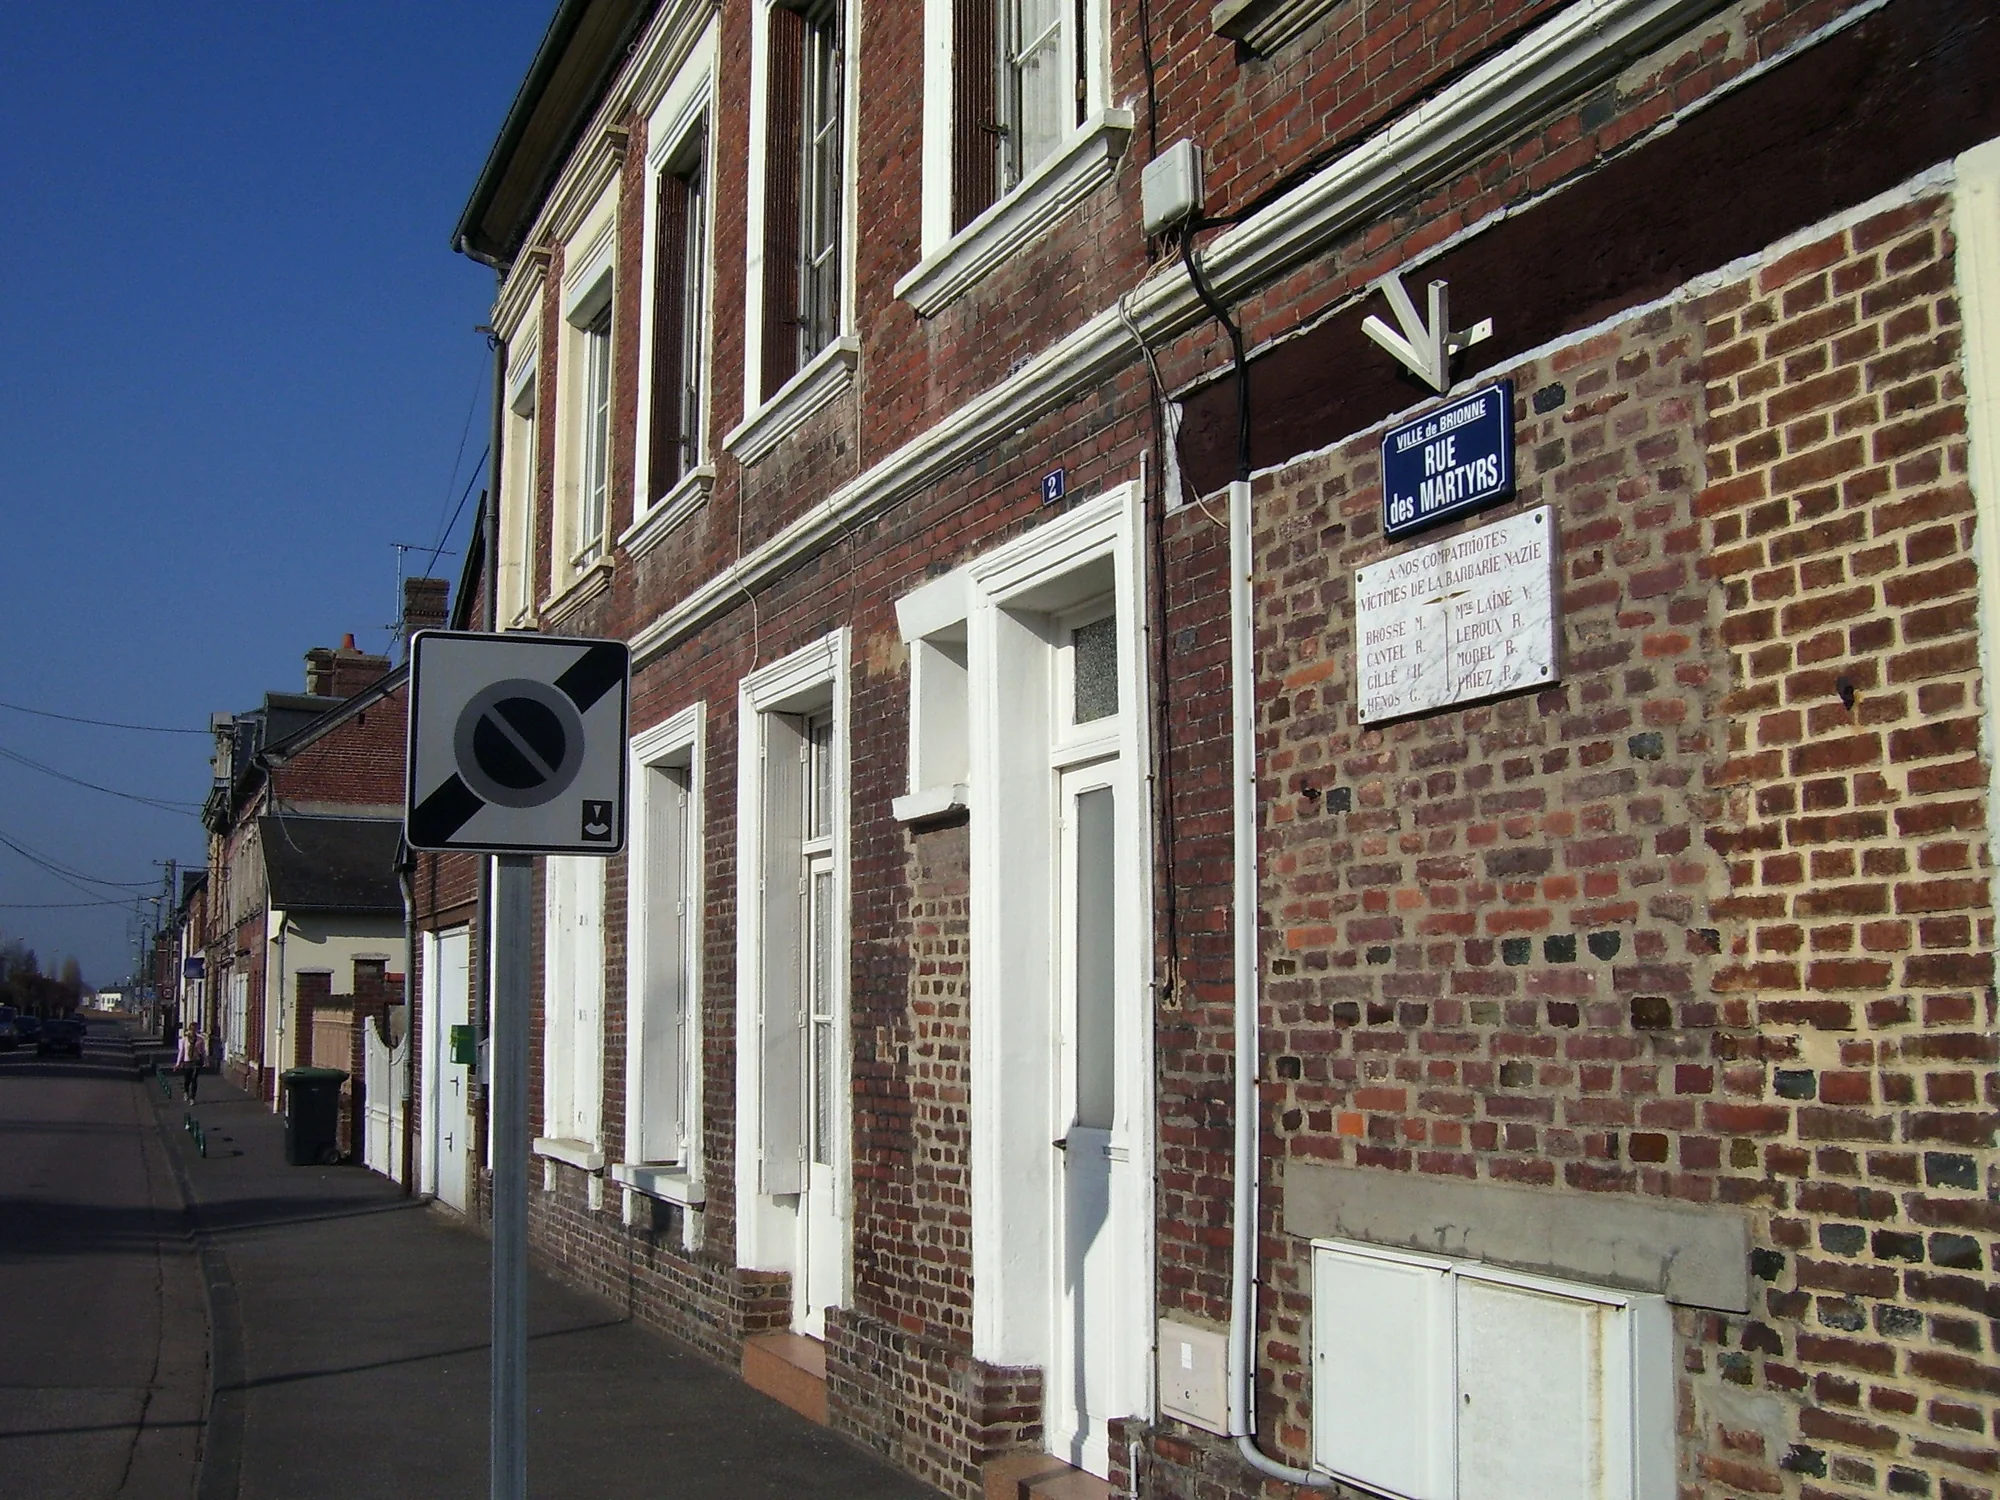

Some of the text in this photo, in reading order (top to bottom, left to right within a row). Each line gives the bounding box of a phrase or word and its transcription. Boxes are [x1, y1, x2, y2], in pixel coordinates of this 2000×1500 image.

[1396, 398, 1486, 450] VILLE de BRIONNE
[1424, 435, 1456, 477] RUE
[1047, 476, 1057, 499] 2
[1390, 454, 1498, 525] des MARTYRS
[1387, 529, 1508, 583] A NOS COMPATRIOTES
[1360, 540, 1542, 612] VICTIMES DE LA BARBARIE NAZIE
[1366, 621, 1406, 646] BROSSE
[1456, 612, 1525, 644] LEROUX R.
[1366, 644, 1406, 668] CANTEL
[1456, 645, 1495, 667] MOREL
[1457, 668, 1493, 690] PRIEZ
